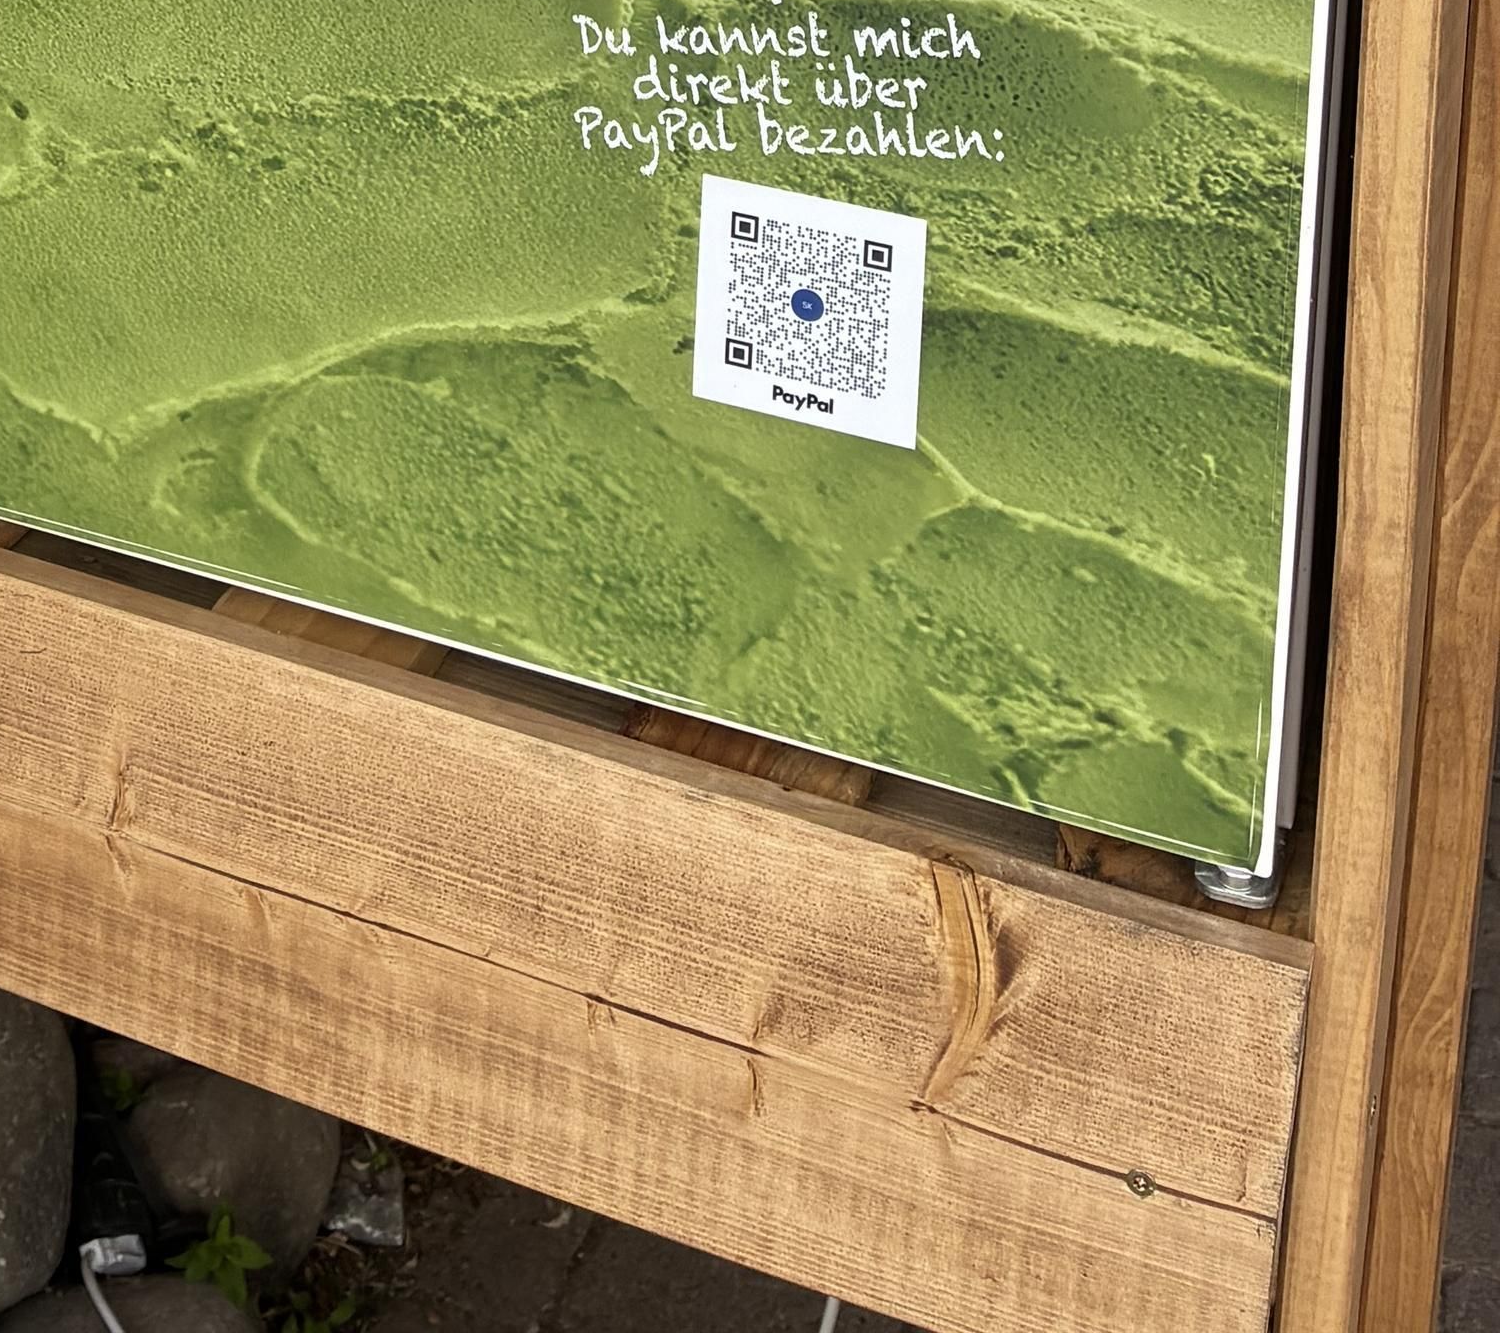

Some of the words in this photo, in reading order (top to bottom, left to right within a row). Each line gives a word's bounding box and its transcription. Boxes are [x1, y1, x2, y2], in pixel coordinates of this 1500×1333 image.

[572, 13, 637, 60] Du
[654, 13, 827, 61] kannst
[852, 13, 981, 61] mich
[633, 59, 795, 108] direkt
[812, 65, 930, 112] über
[572, 104, 738, 177] PayPal
[756, 111, 1006, 163] bezahlen:
[772, 384, 834, 415] PayPal
